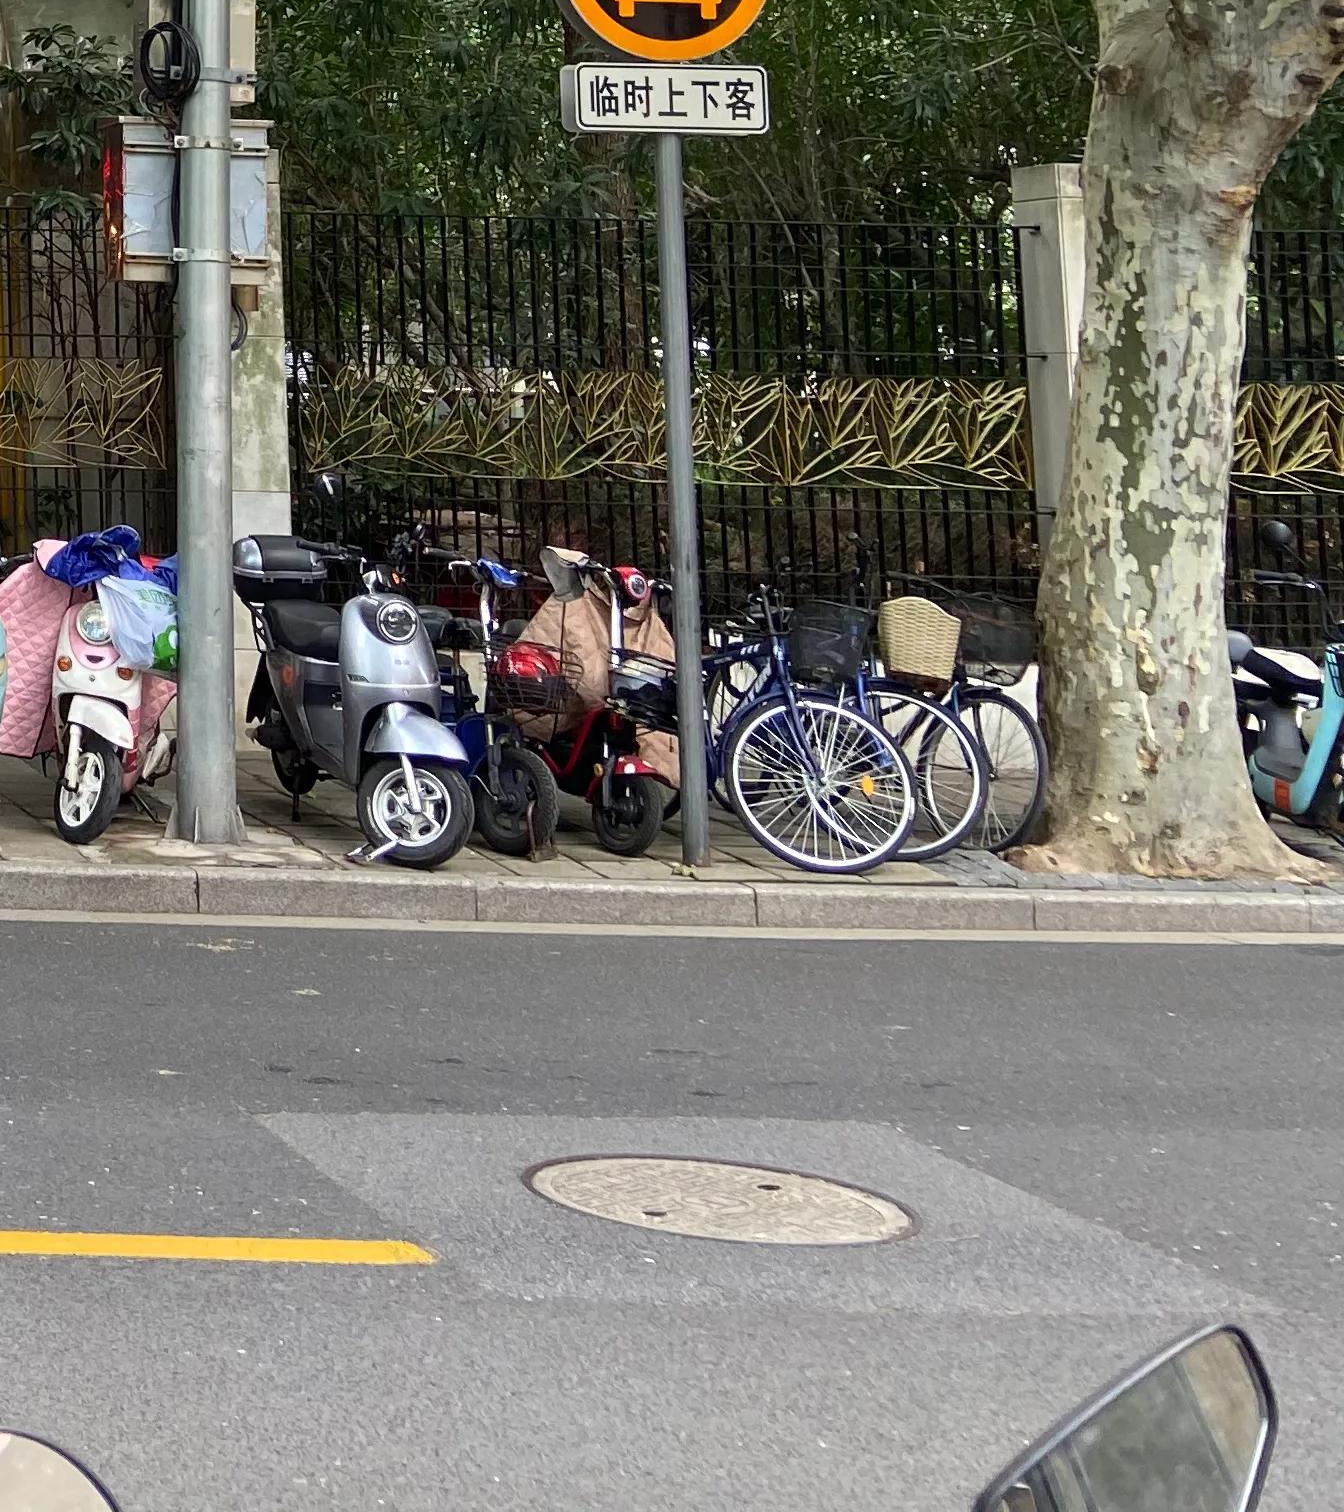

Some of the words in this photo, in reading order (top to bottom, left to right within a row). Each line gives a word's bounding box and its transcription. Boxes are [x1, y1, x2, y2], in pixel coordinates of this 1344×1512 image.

[590, 76, 755, 120] 临时上下客
